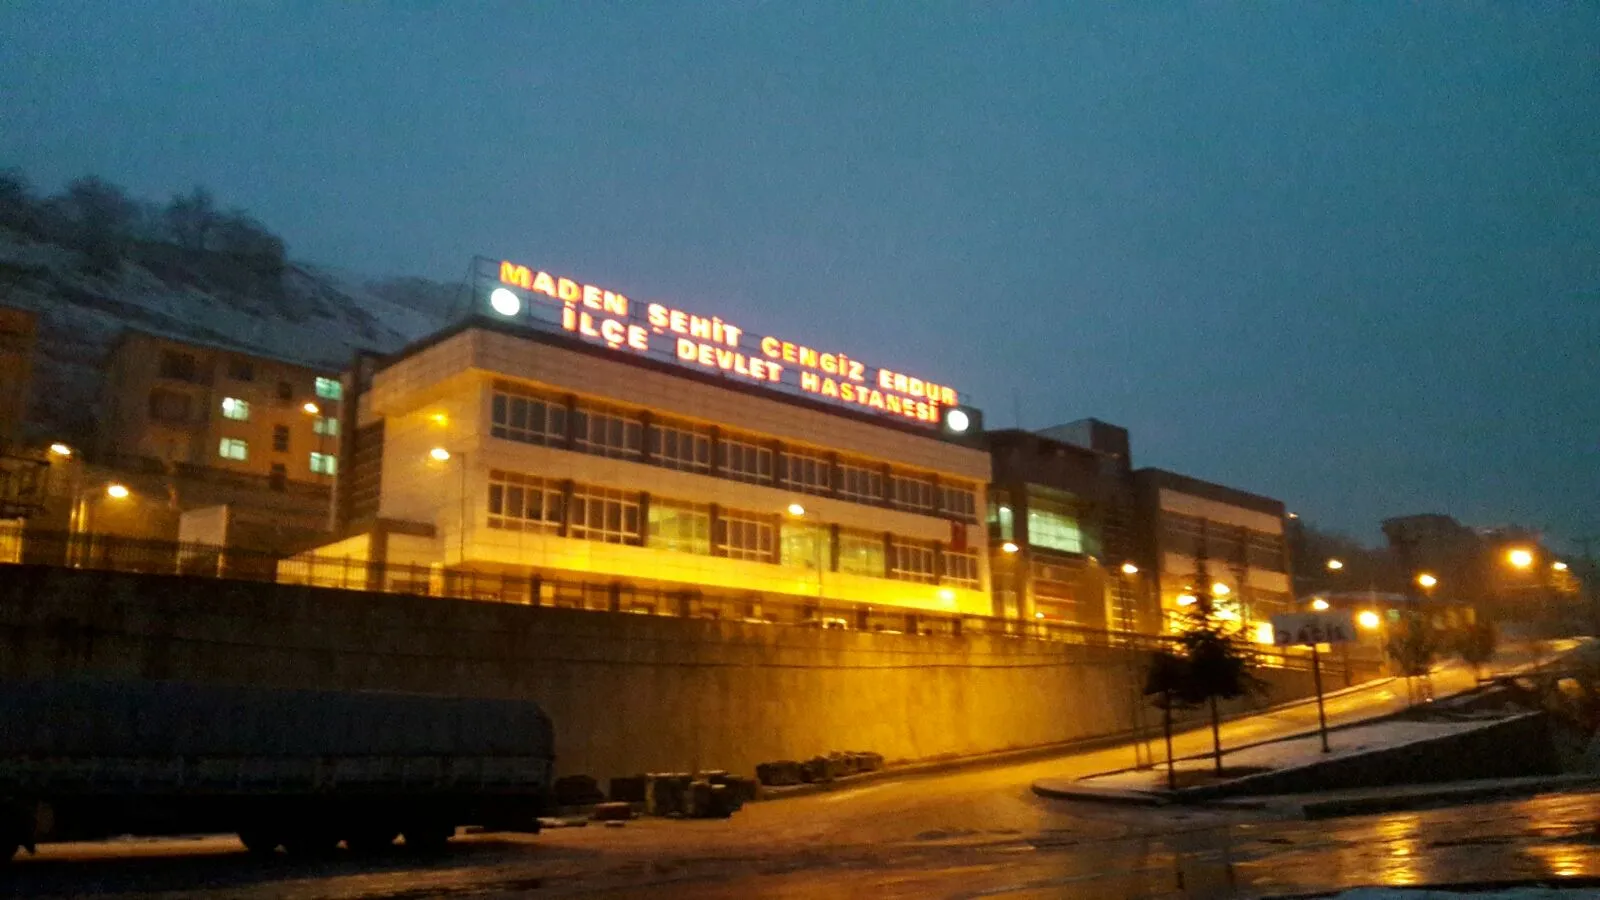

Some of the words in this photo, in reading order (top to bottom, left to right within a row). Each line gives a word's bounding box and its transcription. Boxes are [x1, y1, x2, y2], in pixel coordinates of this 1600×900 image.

[500, 261, 628, 315] MADEN
[648, 303, 741, 347] ŞEHİT
[762, 336, 865, 382] CENGİZ
[878, 369, 957, 405] ERDUR
[562, 302, 648, 350] İLÇE
[677, 338, 783, 382] DEVLET
[801, 371, 939, 422] HASTANESİ
